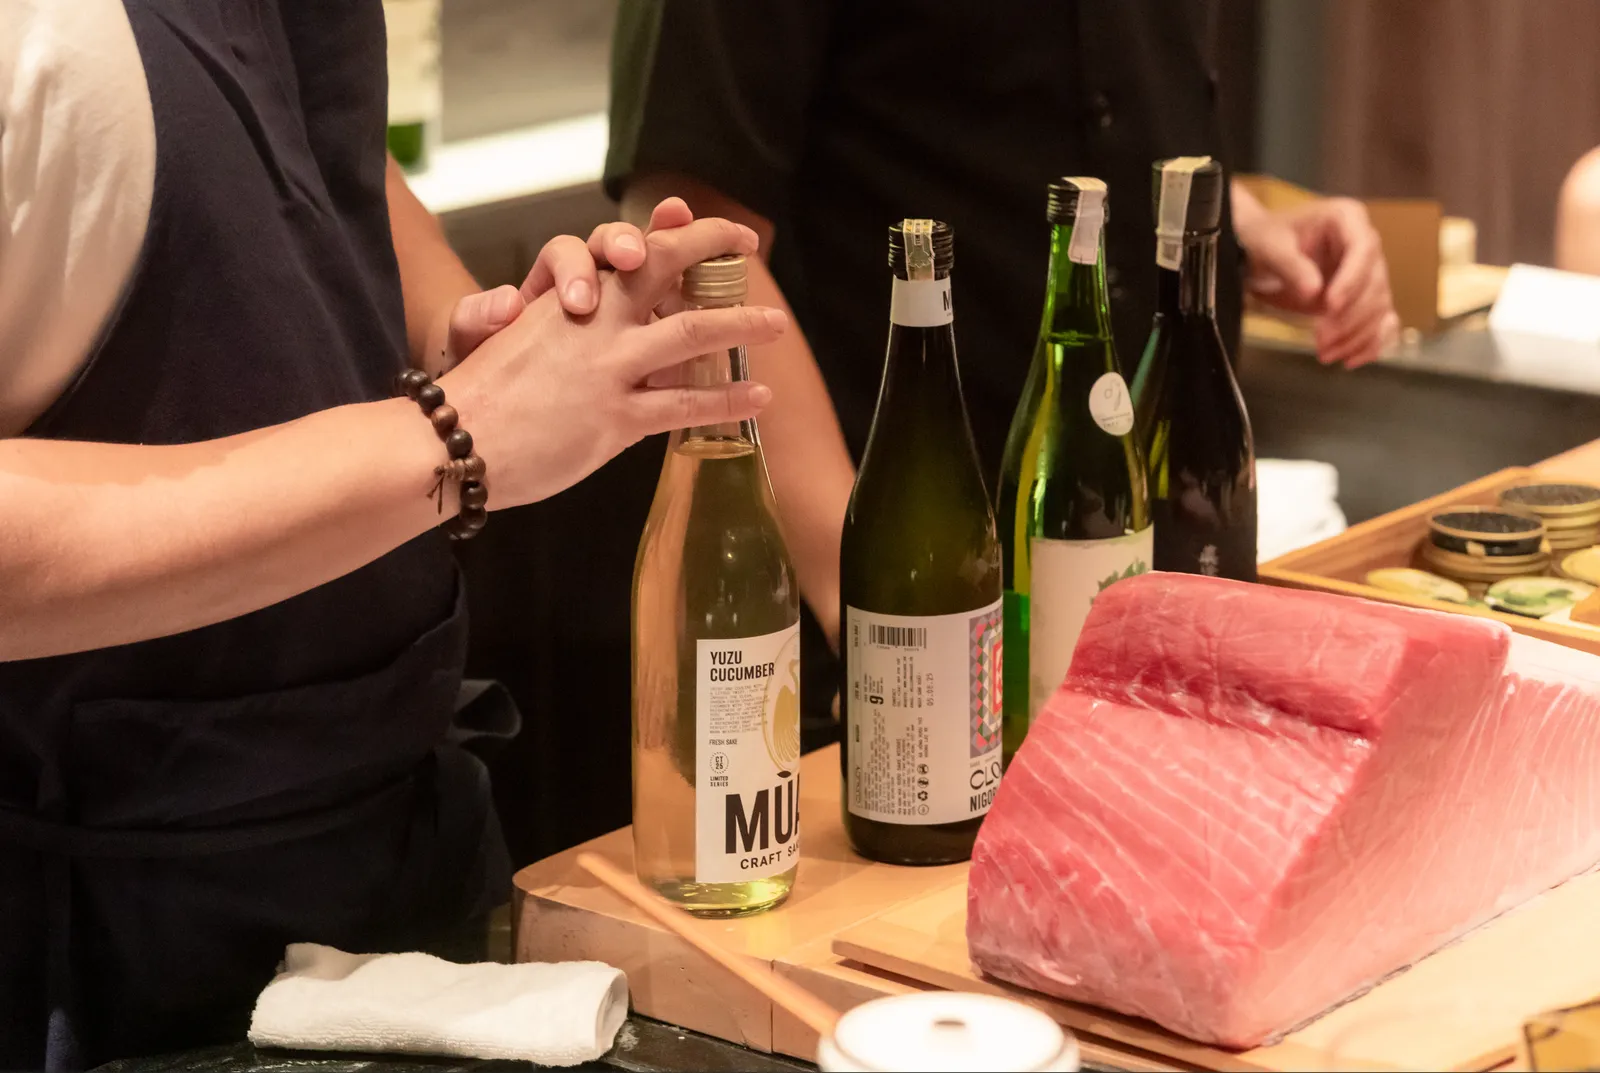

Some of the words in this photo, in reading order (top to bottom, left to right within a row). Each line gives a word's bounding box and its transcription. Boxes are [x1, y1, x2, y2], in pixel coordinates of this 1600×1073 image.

[710, 650, 743, 665] YUZU
[710, 662, 775, 682] CUCUMBER
[709, 738, 725, 746] FRESH
[726, 738, 738, 746] SAKE
[740, 850, 782, 870] CRAFT
